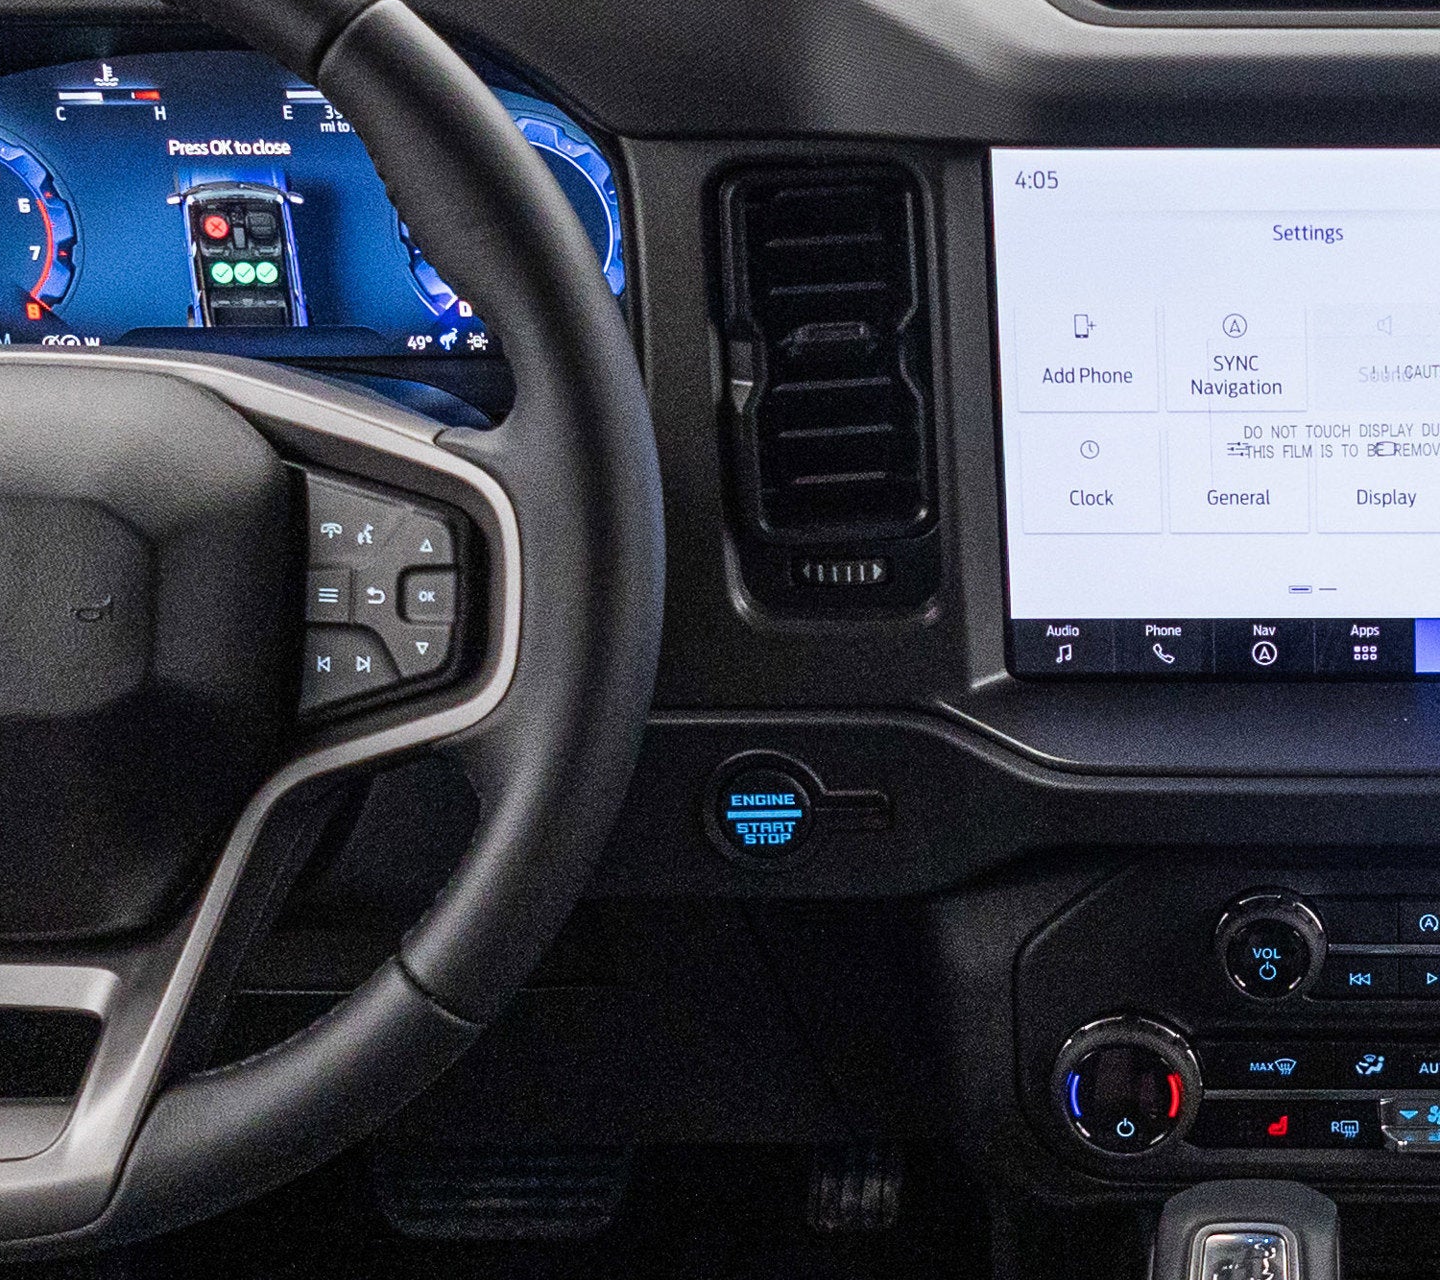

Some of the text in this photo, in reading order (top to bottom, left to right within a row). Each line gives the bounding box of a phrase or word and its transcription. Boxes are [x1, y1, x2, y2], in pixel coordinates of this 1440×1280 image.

[153, 105, 167, 121] H
[282, 104, 294, 121] E
[168, 139, 292, 156] Press OK to close
[1014, 170, 1059, 190] 4:05
[18, 198, 31, 213] 6
[1272, 224, 1344, 245] Settings
[29, 245, 41, 261] 7
[26, 302, 42, 321] 8
[407, 334, 433, 350] 49°
[1213, 354, 1259, 372] SYNC
[1042, 366, 1134, 384] Add Phone
[1190, 378, 1283, 399] Navigation
[1244, 426, 1263, 439] DO
[1271, 425, 1297, 439] NOT
[1306, 424, 1351, 439] TOUCH
[1359, 424, 1414, 438] DISPLAY
[1283, 445, 1312, 458] FILM
[1321, 445, 1333, 457] IS
[1343, 444, 1359, 457] TO
[1069, 489, 1114, 507] Clock
[1206, 488, 1271, 506] General
[1356, 488, 1417, 508] Display
[417, 590, 436, 603] OK
[1045, 624, 1080, 637] Audio
[1144, 624, 1182, 637] Phone
[1252, 624, 1277, 643] Nav
[1349, 623, 1381, 638] Apps
[729, 792, 798, 808] ENGINE
[736, 821, 796, 833] START
[744, 833, 792, 845] STOP
[1251, 947, 1281, 960] VOL
[1249, 1062, 1274, 1071] MAX
